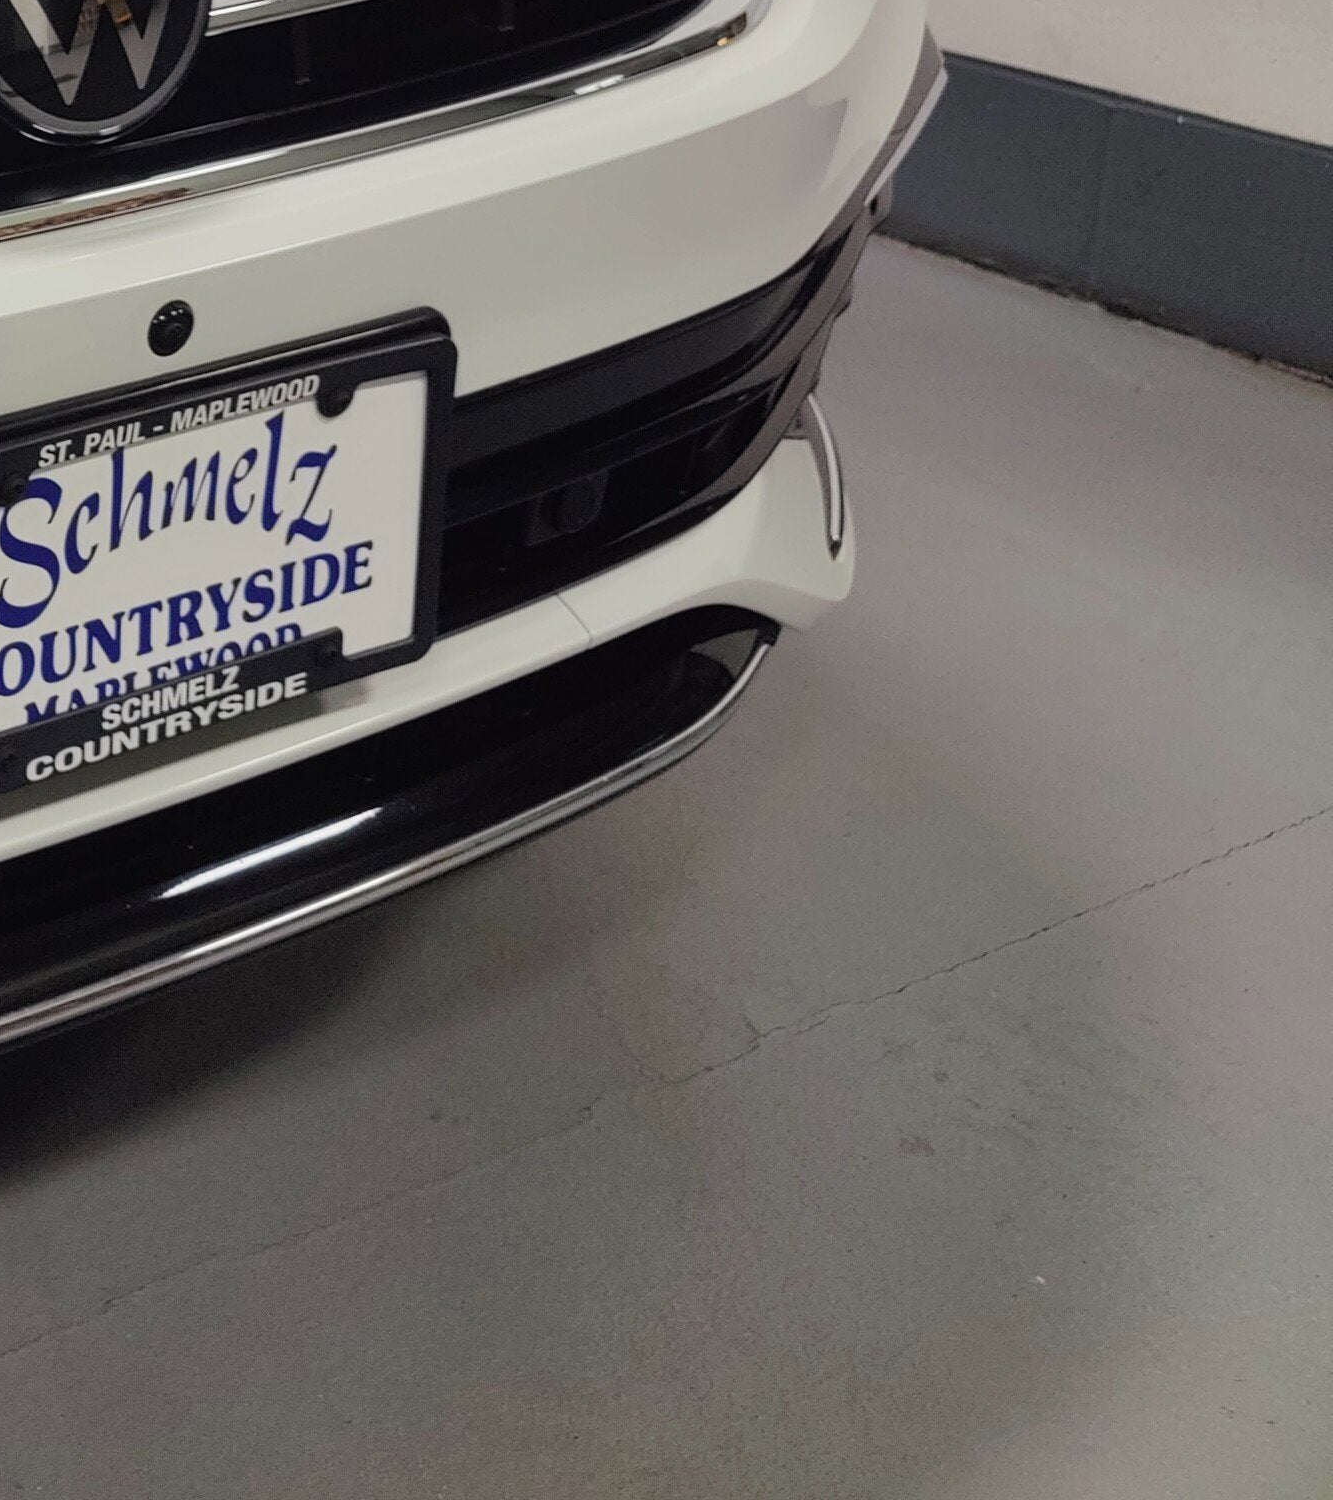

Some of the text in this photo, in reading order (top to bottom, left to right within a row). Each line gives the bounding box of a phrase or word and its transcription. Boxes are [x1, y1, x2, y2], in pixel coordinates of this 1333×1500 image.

[37, 439, 76, 468] ST.
[83, 421, 146, 456] PAUL
[170, 374, 321, 432] MAPLEWOOD
[26, 671, 308, 782] COUNTRYSIDE
[101, 665, 240, 730] SCHMELZ
